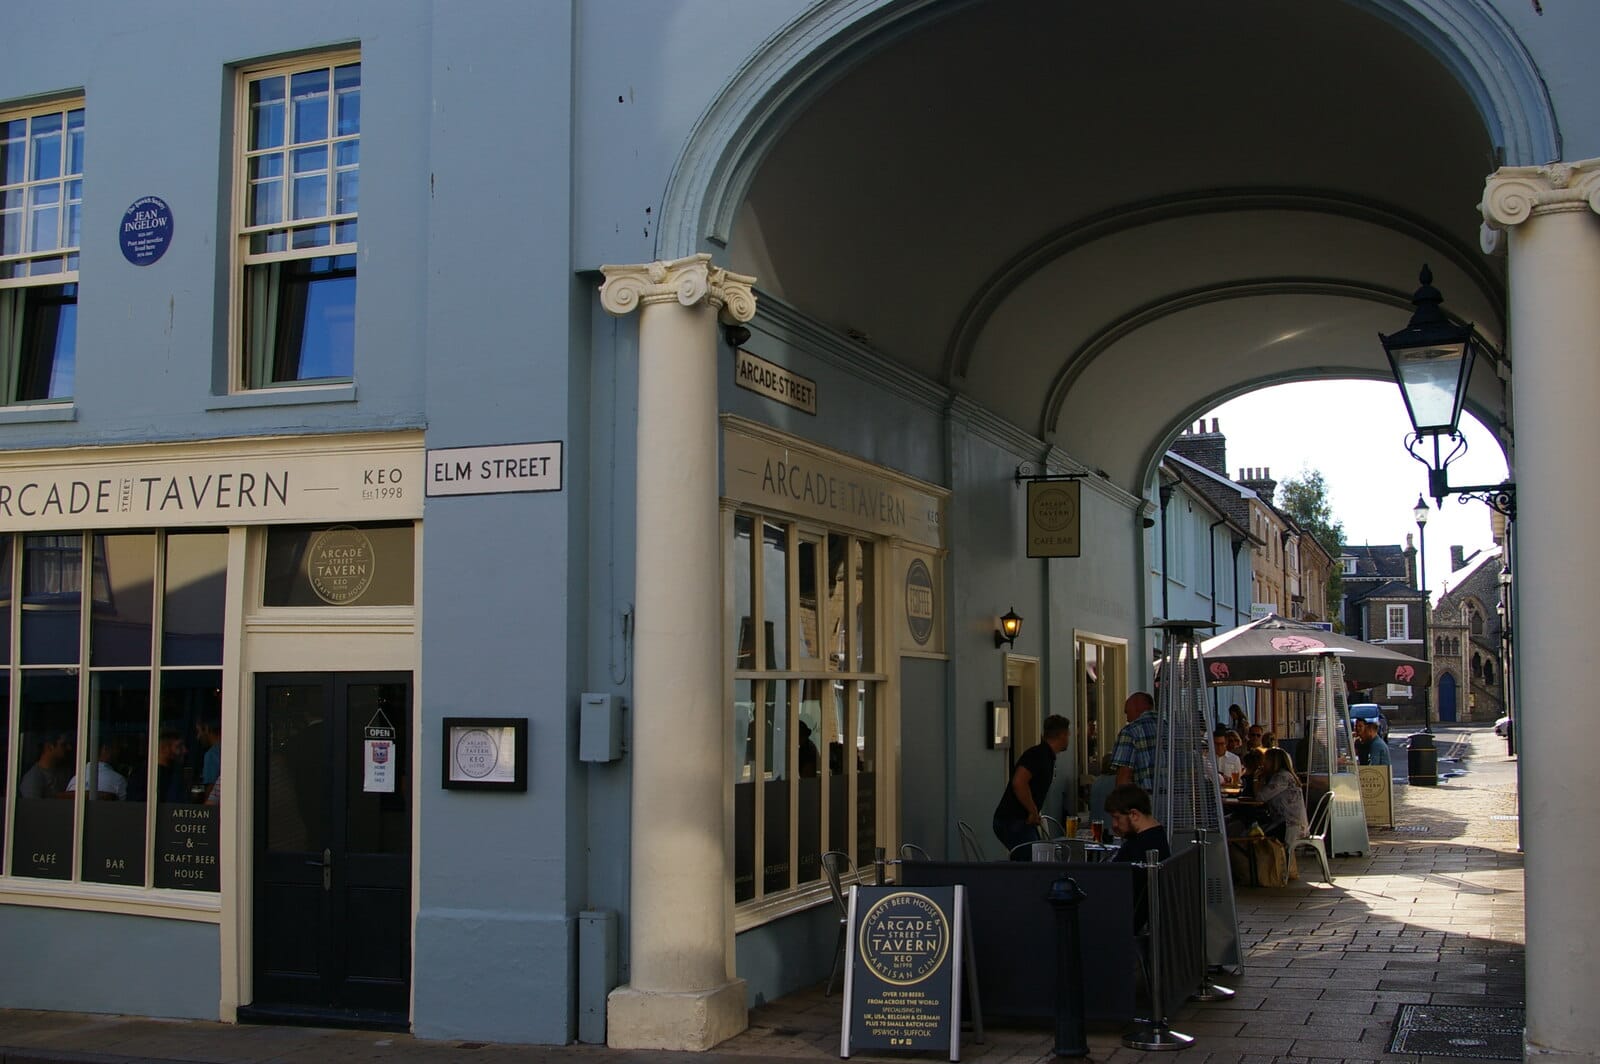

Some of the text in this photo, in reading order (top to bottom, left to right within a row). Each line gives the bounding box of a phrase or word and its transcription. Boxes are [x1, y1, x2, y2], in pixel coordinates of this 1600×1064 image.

[135, 209, 158, 221] JEAN
[125, 217, 168, 232] INGELOW
[740, 360, 812, 404] ARCADE STREET
[435, 457, 551, 482] ELM STREET
[363, 468, 403, 485] KEO
[121, 478, 131, 512] STREET
[140, 471, 288, 511] TAVERN
[375, 487, 403, 499] 1998
[762, 457, 837, 509] ARCADE
[847, 483, 906, 528] TAVERN
[320, 548, 363, 559] ARCADE
[317, 564, 366, 576] TAVERN
[314, 577, 331, 596] CRAFT
[348, 578, 367, 597] HOUSE
[369, 728, 390, 737] OPEN
[172, 809, 210, 818] ARTISAN
[174, 824, 206, 834] COFFEE
[185, 838, 194, 848] &
[32, 852, 57, 864] CAFÉ
[106, 858, 125, 869] BAR
[164, 854, 216, 865] CRAFT BEER
[174, 869, 204, 879] HOUSE
[869, 904, 889, 926] CRAFT
[891, 897, 911, 907] BEER
[912, 899, 937, 918] HOUSE
[877, 920, 932, 930] ARCADE
[873, 939, 936, 951] TAVERN
[871, 957, 935, 979] ARTISAN GIN
